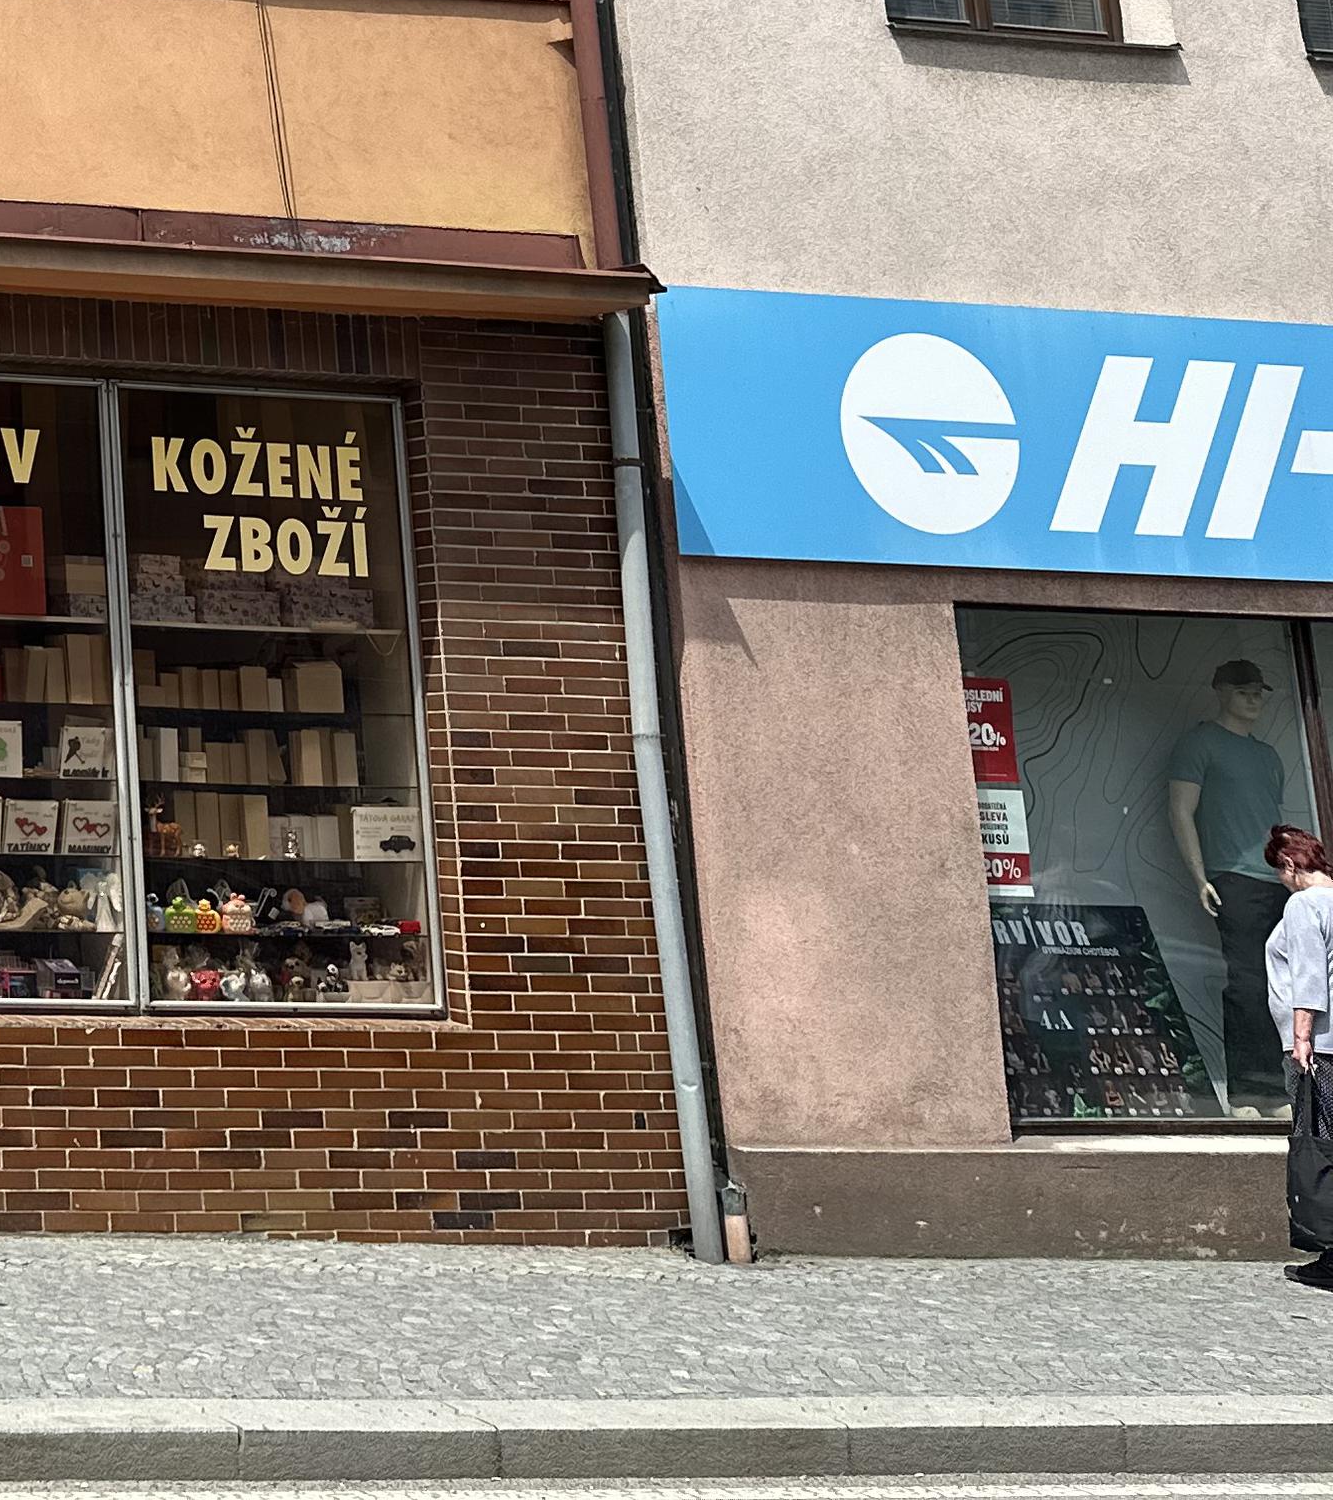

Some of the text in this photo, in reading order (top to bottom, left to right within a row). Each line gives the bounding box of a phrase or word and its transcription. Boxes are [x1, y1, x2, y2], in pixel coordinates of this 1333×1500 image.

[151, 426, 364, 502] KOŽENÉ
[202, 506, 370, 579] ZBOŽÍ
[963, 687, 1003, 703] OSLEDNÍ
[965, 701, 983, 713] USY
[980, 811, 1008, 822] SLEVA
[982, 830, 1010, 845] KUSŮ
[990, 905, 1092, 949] RVIVOR
